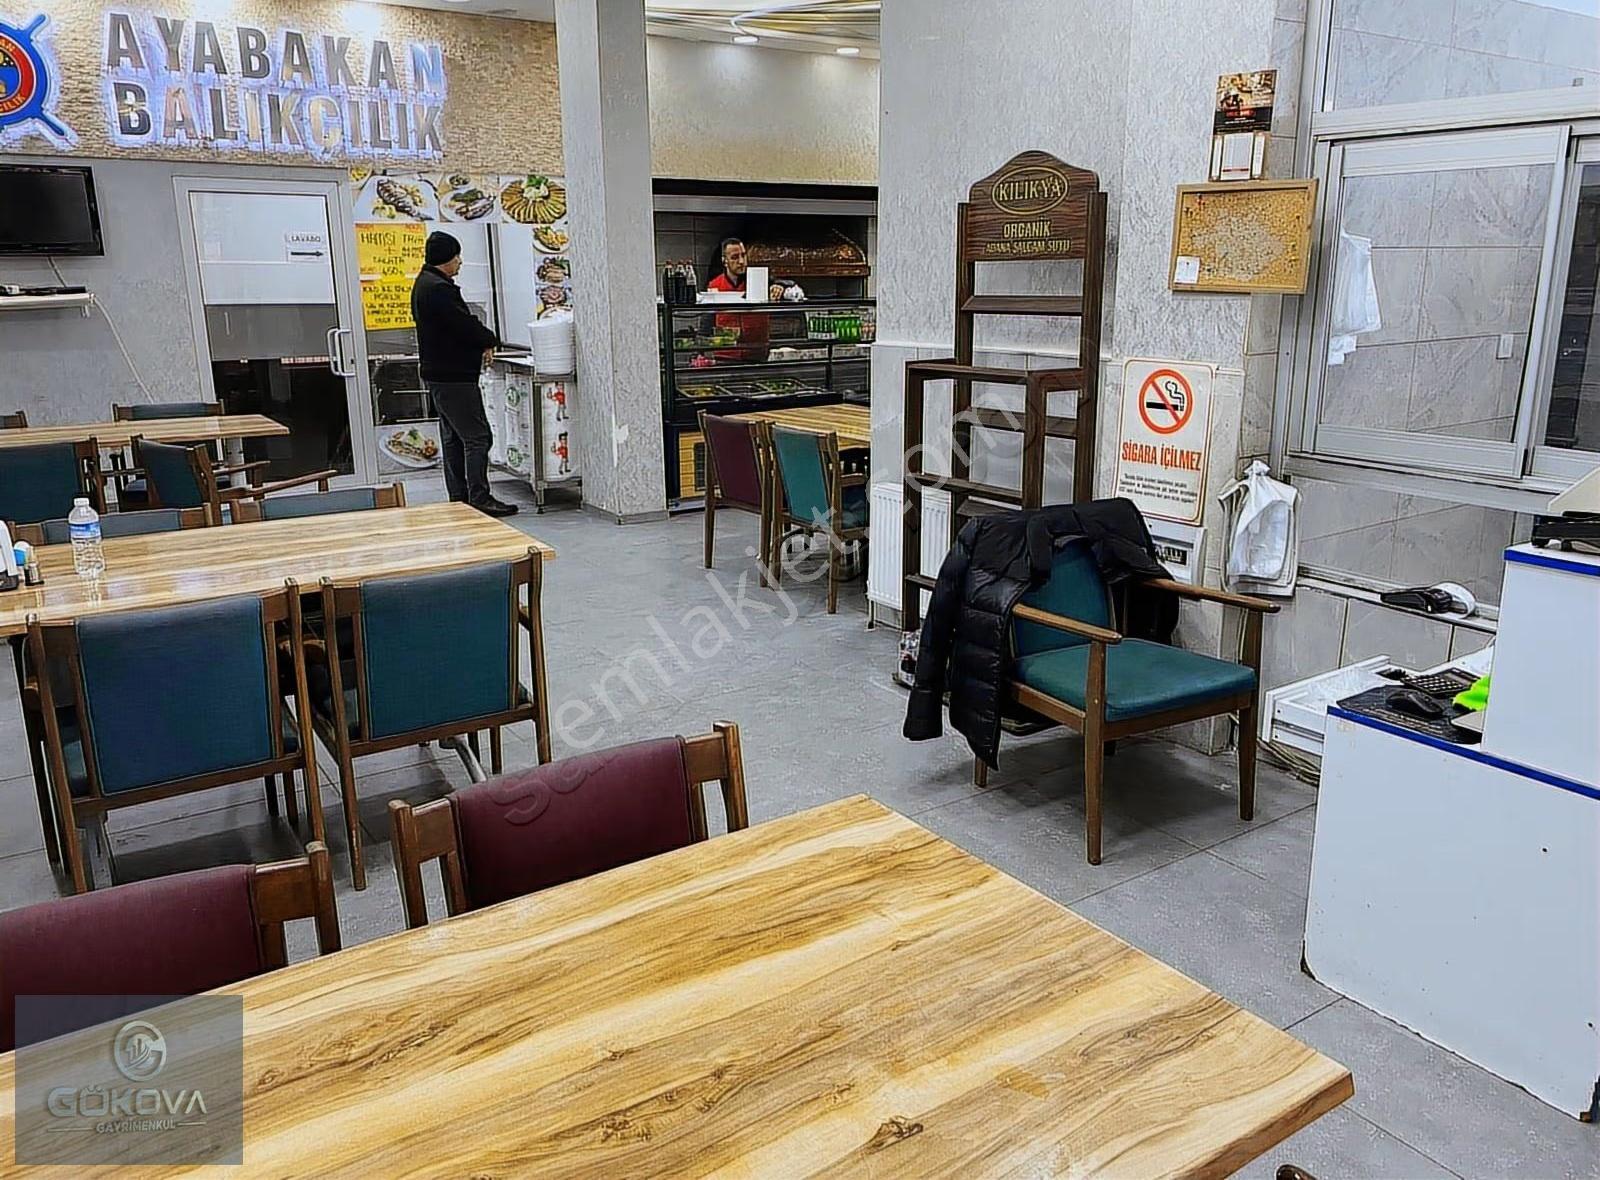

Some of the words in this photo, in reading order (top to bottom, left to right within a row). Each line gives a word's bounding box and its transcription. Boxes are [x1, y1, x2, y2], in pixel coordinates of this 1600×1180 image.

[107, 12, 443, 92] AYABAKAN
[114, 81, 442, 154] BALIKÇILIK
[291, 235, 321, 243] LAVABO
[1121, 440, 1157, 465] SİGARA
[1160, 444, 1202, 471] İÇİLMEZ
